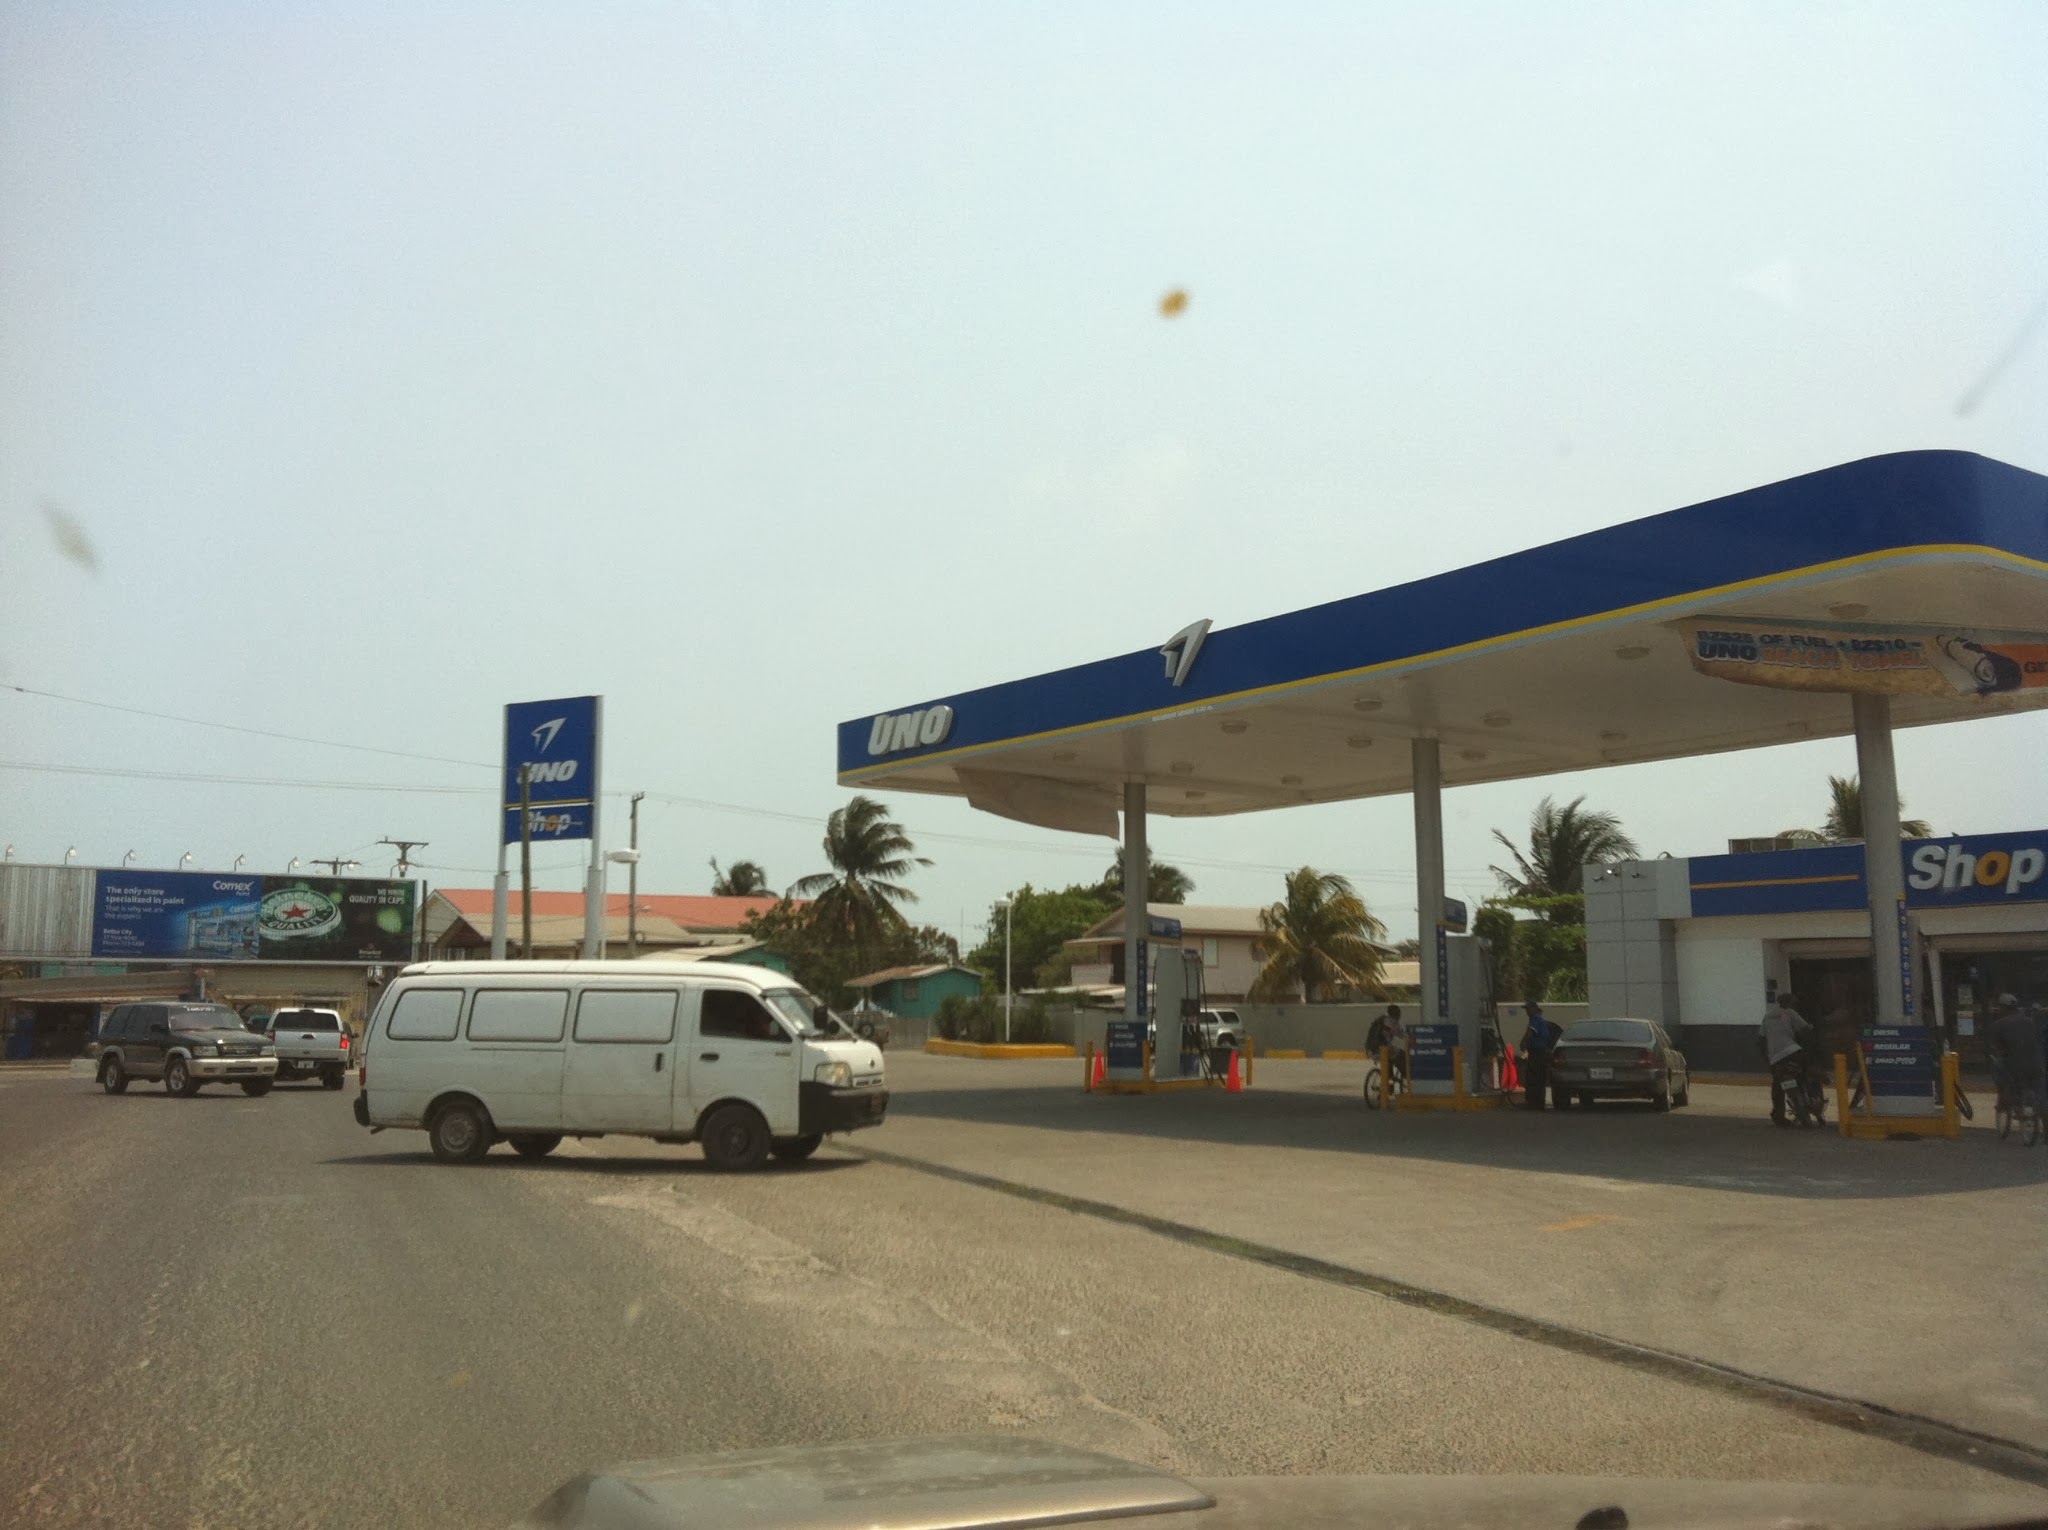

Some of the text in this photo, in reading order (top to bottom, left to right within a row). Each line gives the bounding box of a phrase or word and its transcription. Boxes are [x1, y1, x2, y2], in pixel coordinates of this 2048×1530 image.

[1790, 635, 1833, 647] FUEL
[1698, 642, 1758, 662] UNO
[867, 705, 954, 755] UNO
[1908, 844, 2045, 894] Shop
[106, 886, 164, 896] The only store
[213, 880, 255, 891] Comex
[106, 895, 184, 906] specialized in paint
[348, 895, 378, 904] QUALITY
[387, 896, 405, 905] CAPS
[267, 916, 324, 930] QUALITY
[1874, 1043, 1911, 1051] REGULAR
